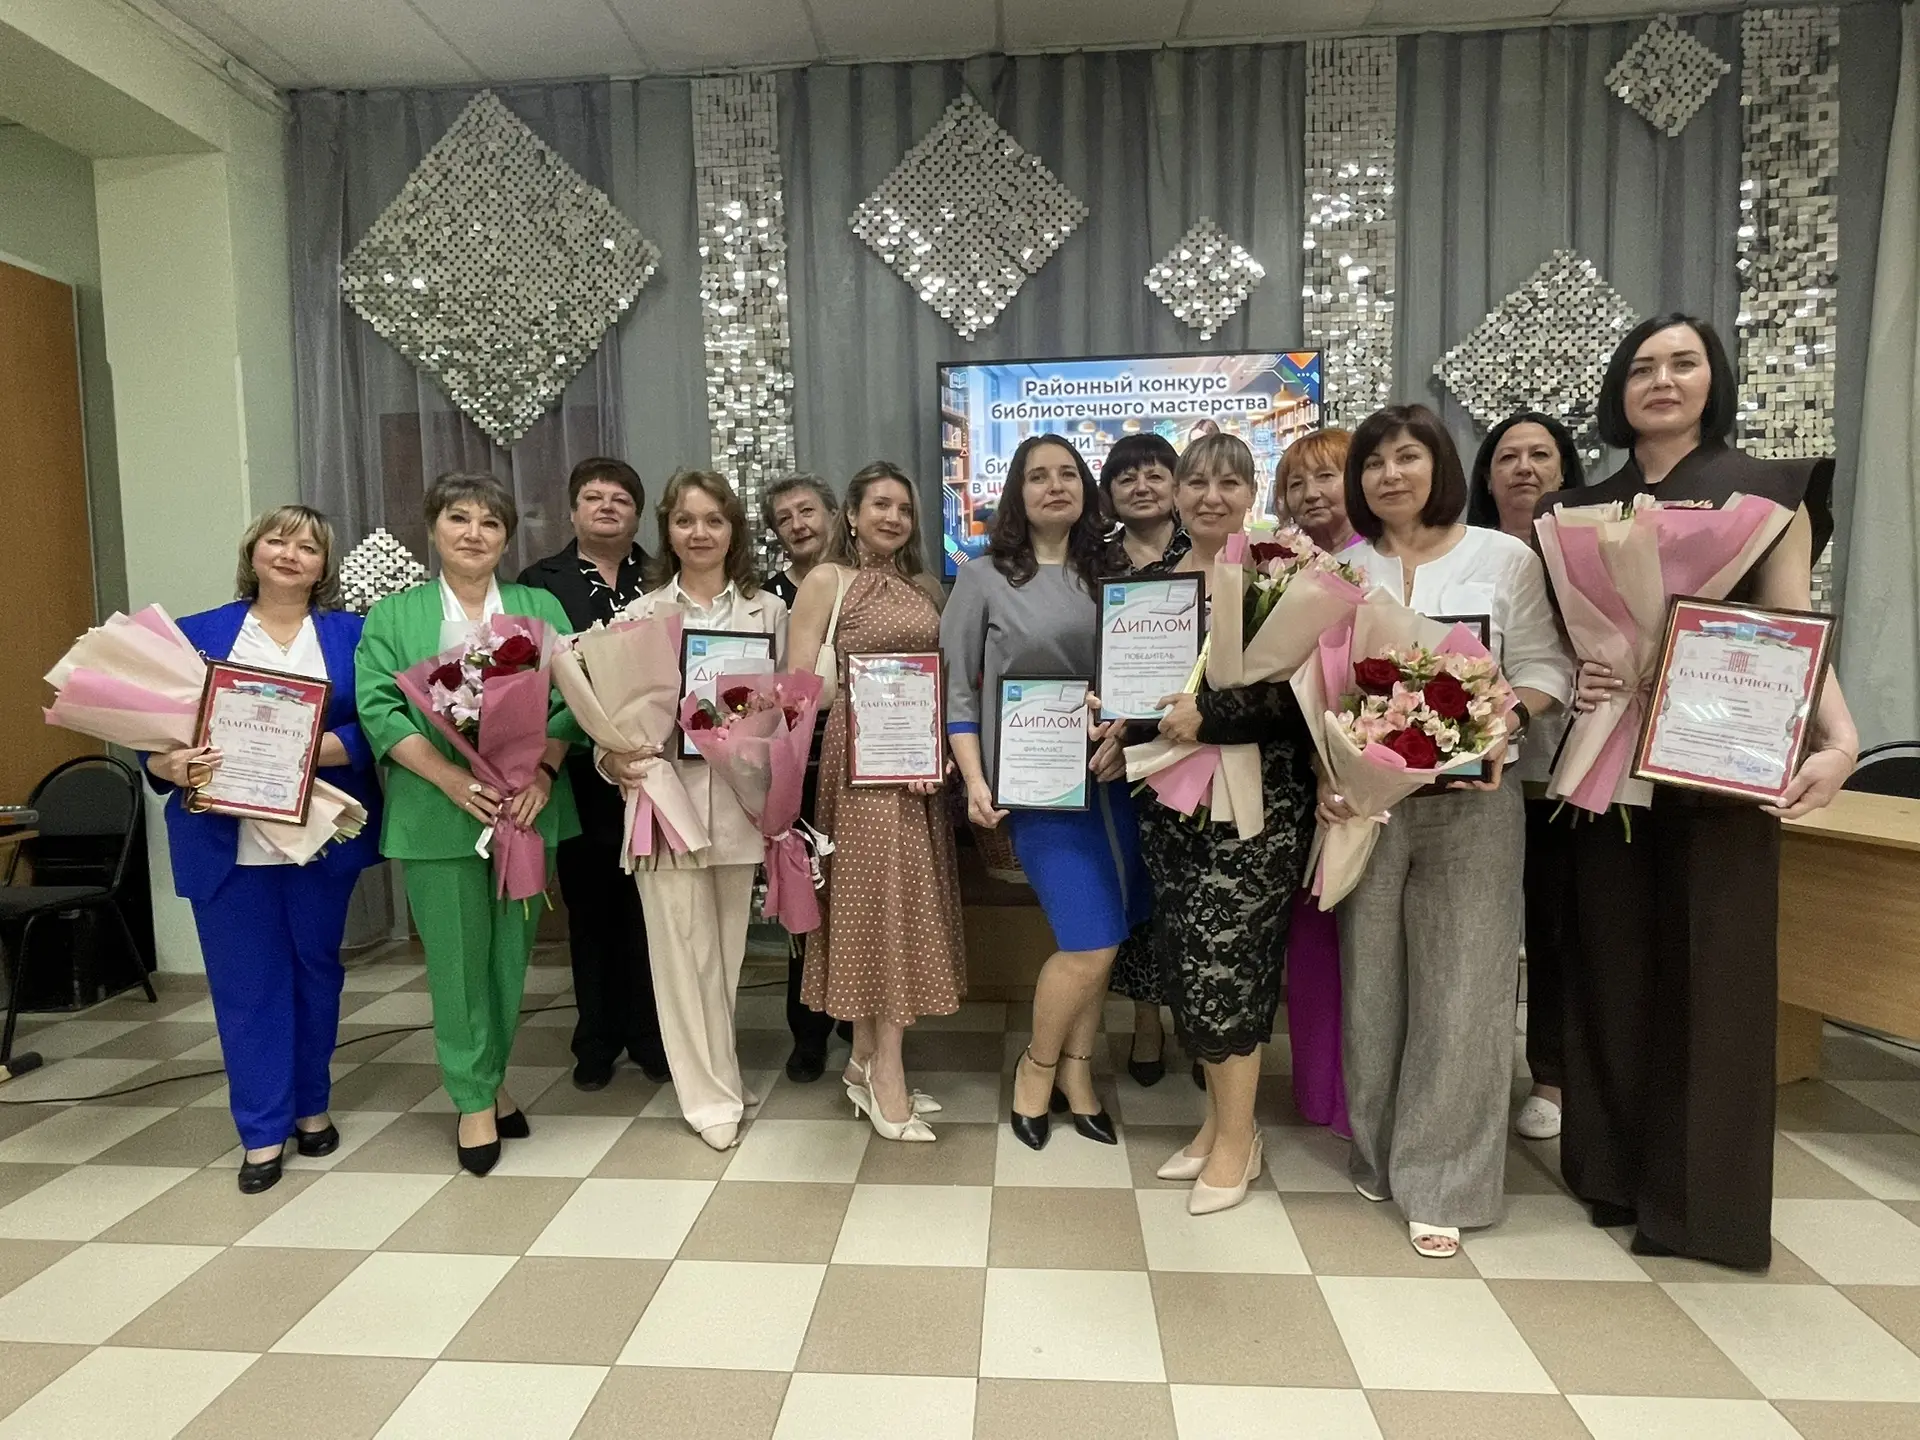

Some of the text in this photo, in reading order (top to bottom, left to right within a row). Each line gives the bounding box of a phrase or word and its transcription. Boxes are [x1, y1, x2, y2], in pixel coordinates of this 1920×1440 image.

[1025, 376, 1227, 397] Районный конкурс
[991, 397, 1268, 420] библиотечного мастерства
[1124, 652, 1174, 660] ПОБЕДИТЕЛЬ
[1679, 667, 1793, 693] БЛАГОДАРНОСТЬ
[218, 718, 304, 738] БЛАГОДАРНОСТЬ
